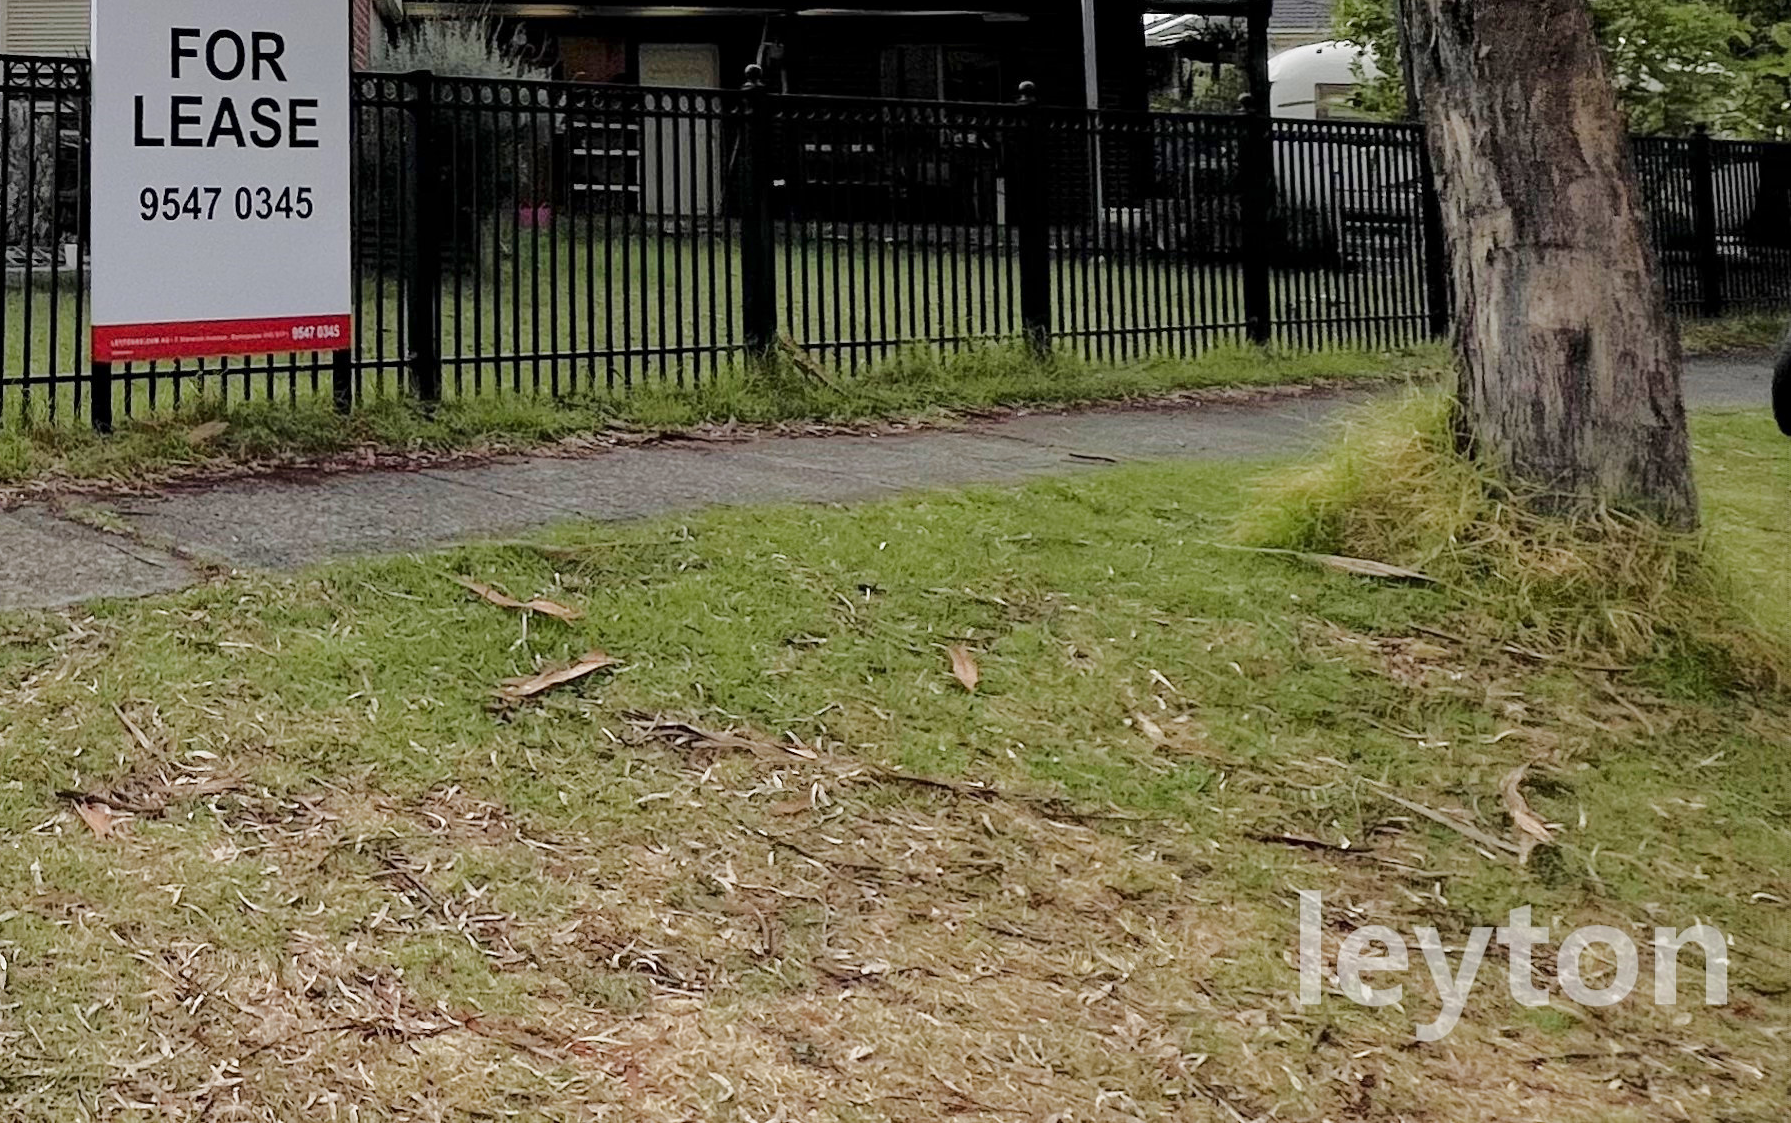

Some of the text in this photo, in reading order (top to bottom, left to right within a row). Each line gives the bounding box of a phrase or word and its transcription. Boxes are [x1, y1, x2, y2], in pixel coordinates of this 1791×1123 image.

[170, 27, 288, 82] FOR
[133, 94, 319, 148] LEASE
[140, 186, 314, 221] 9547 0345
